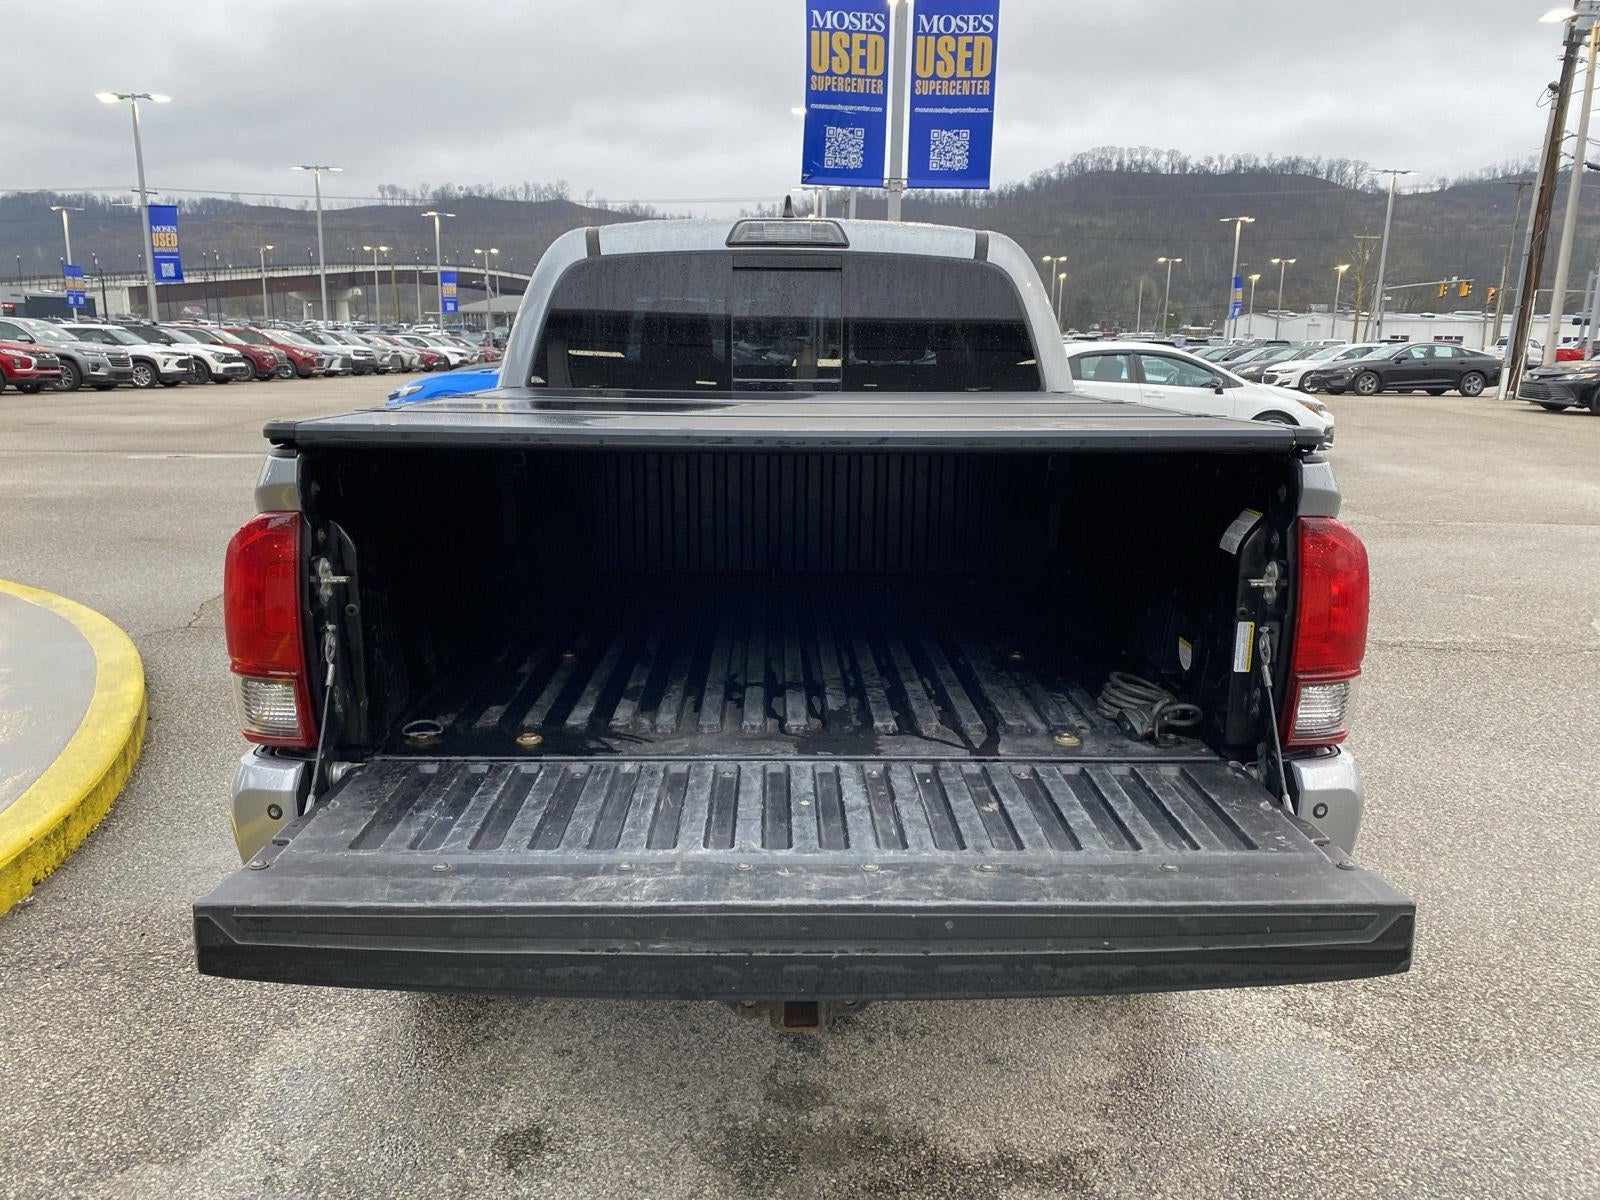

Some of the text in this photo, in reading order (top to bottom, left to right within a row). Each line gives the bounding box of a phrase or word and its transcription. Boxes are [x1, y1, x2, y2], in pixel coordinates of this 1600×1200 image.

[812, 10, 885, 32] MOSES
[917, 14, 994, 34] MOSES
[810, 31, 885, 76] USED
[915, 35, 993, 78] USED
[810, 75, 884, 95] SUPERCENTER
[915, 79, 990, 96] SUPERCENTER
[152, 233, 178, 247] USED
